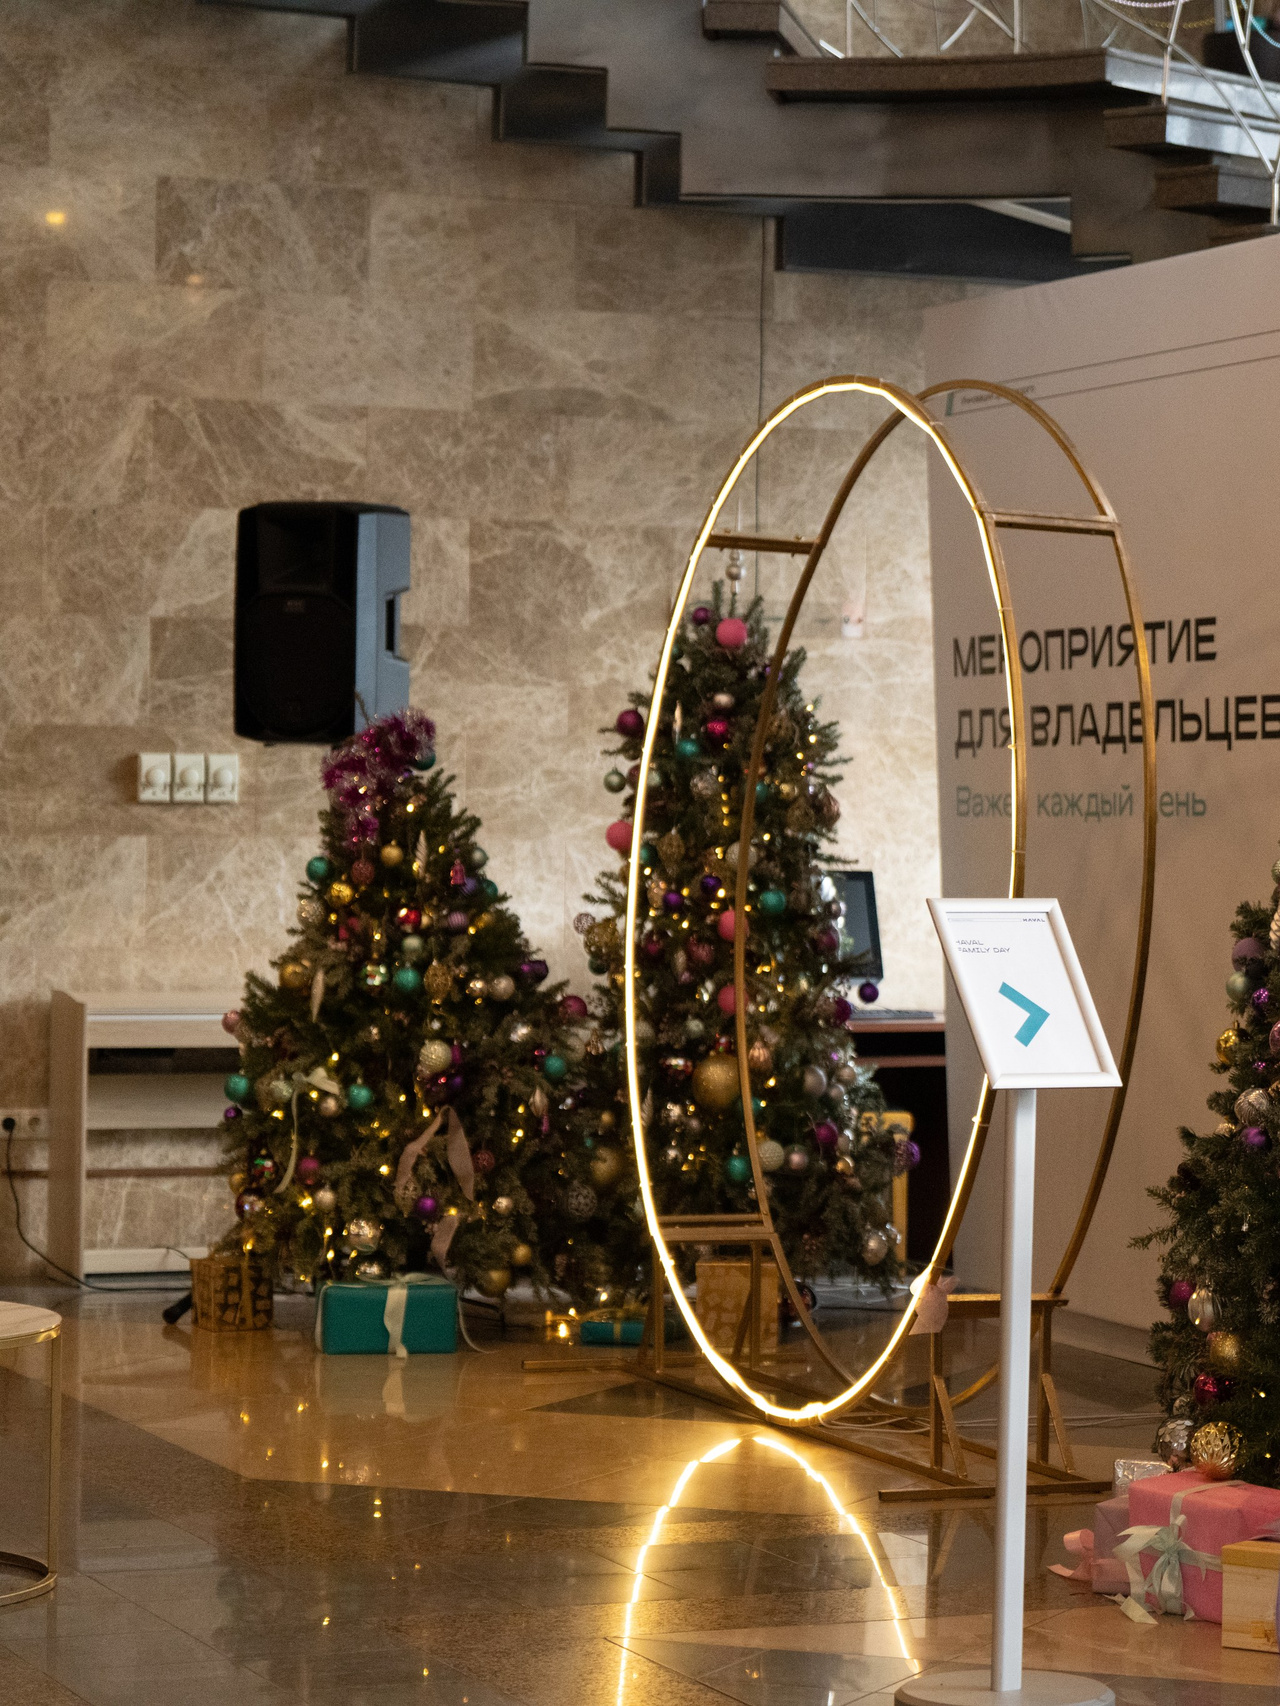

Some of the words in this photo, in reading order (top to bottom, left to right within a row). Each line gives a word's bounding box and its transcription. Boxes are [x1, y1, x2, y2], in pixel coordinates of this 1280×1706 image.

[955, 707, 1012, 759] ДЛЯ
[956, 785, 1013, 817] Важе
[1037, 784, 1133, 822] каждый
[1159, 790, 1207, 818] ень
